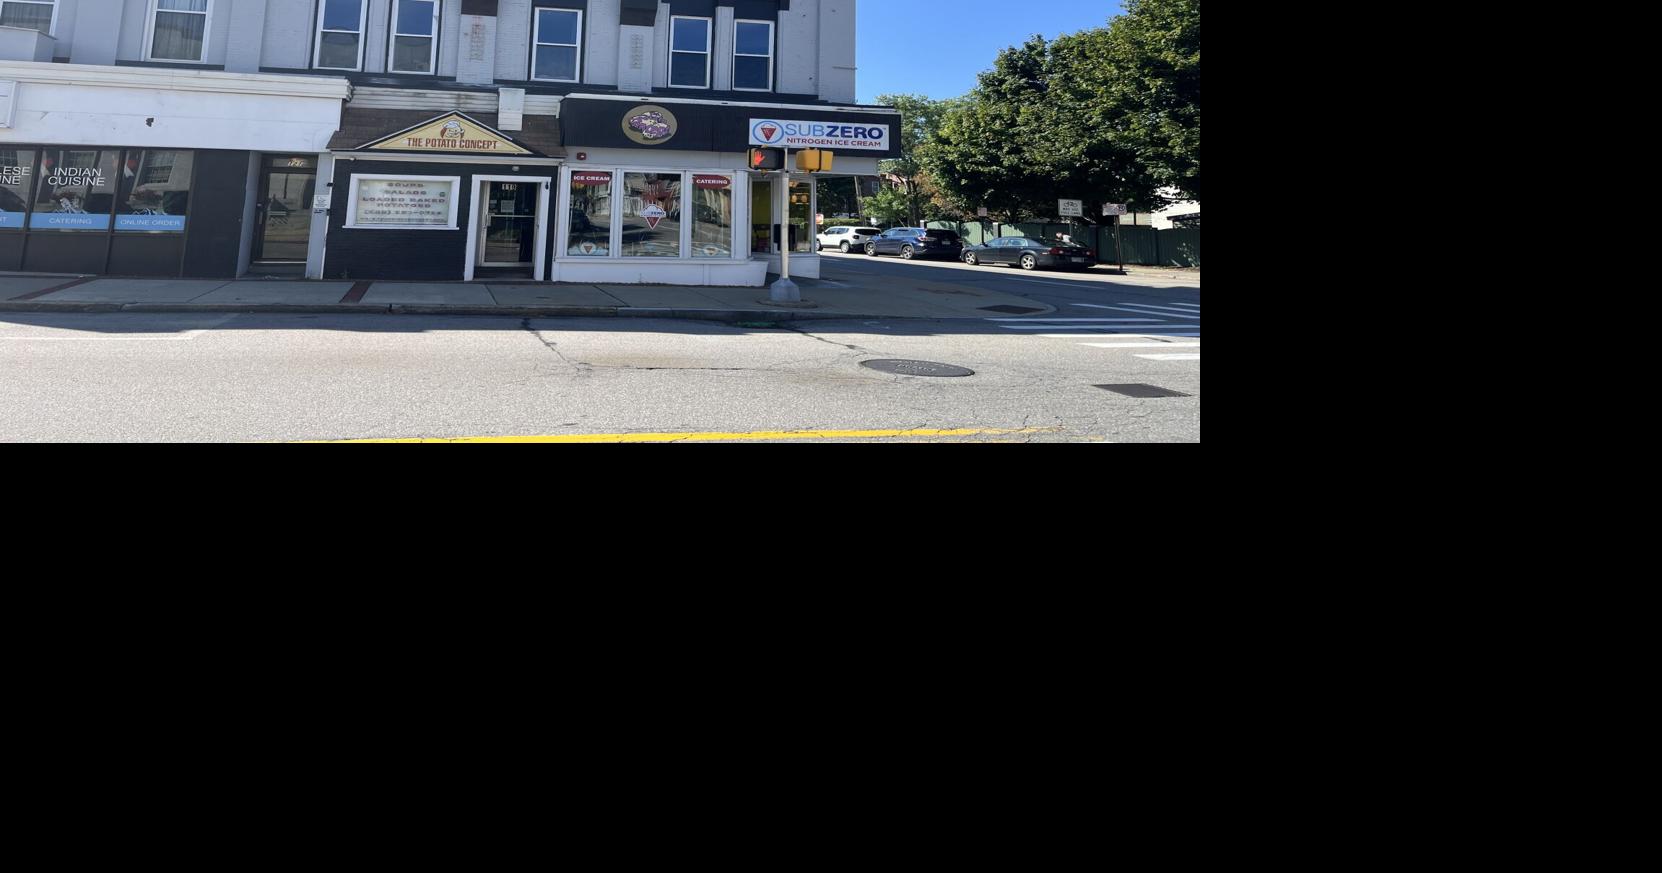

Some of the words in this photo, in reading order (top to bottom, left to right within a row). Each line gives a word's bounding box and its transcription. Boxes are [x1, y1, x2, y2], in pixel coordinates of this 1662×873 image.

[407, 137, 423, 147] THE
[425, 138, 457, 149] POTATO
[459, 139, 498, 150] CONCEPT
[787, 137, 833, 146] NITROGEN
[834, 139, 849, 147] ICE
[53, 167, 102, 177] INDIAN
[47, 176, 105, 187] CUISINE
[48, 217, 92, 226] CATERING
[120, 218, 149, 226] ONLINE
[151, 219, 180, 227] ORDER
